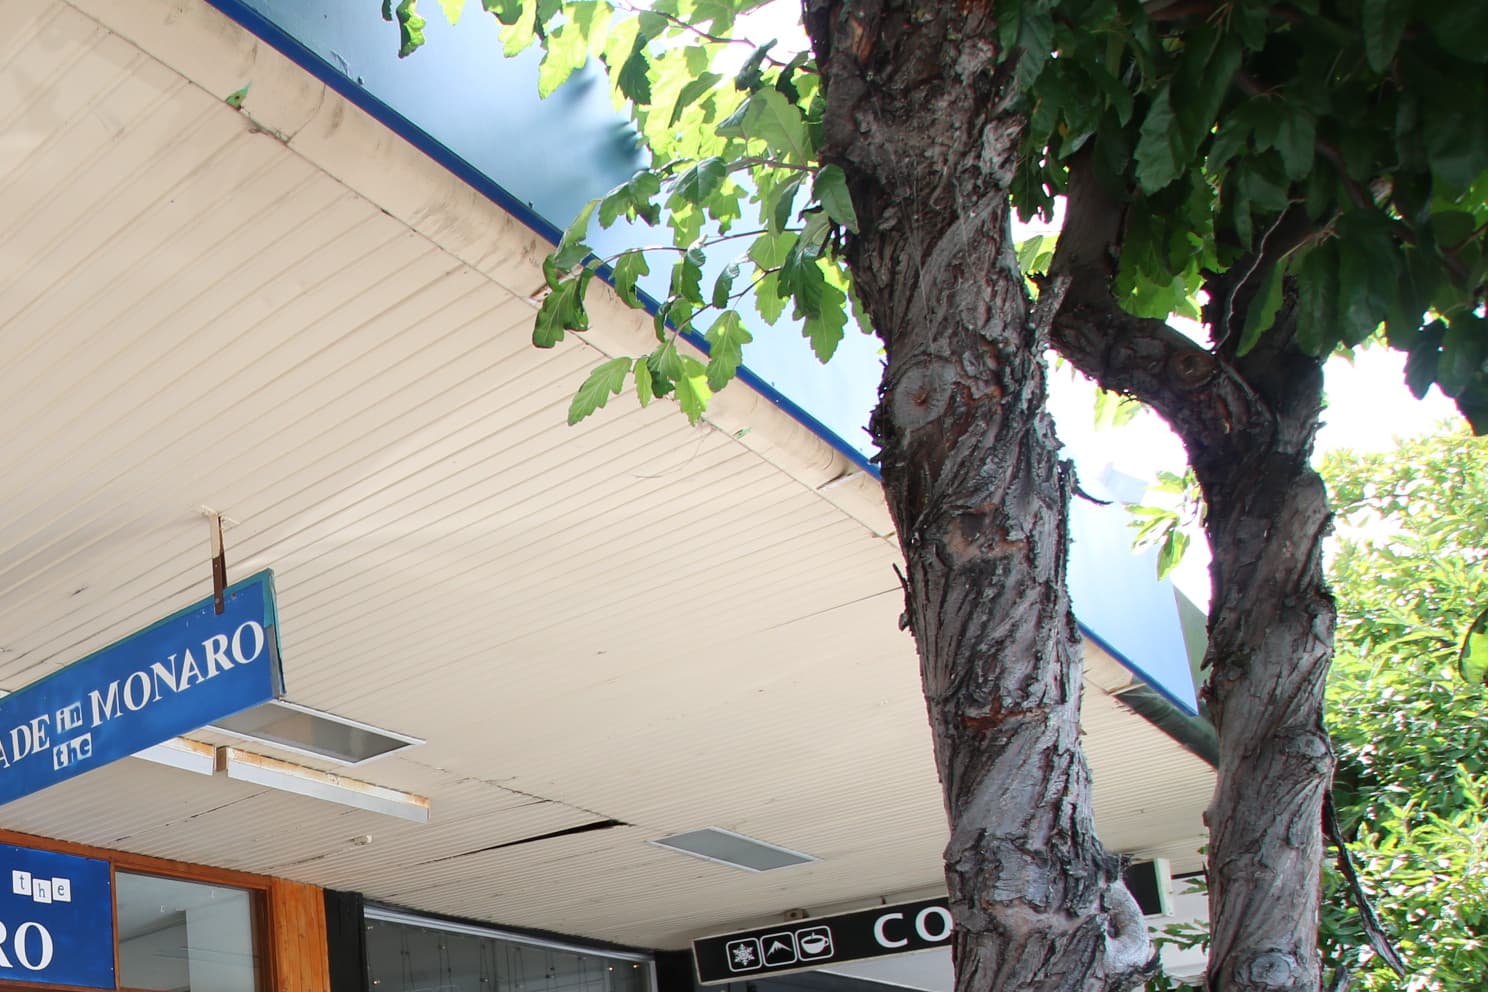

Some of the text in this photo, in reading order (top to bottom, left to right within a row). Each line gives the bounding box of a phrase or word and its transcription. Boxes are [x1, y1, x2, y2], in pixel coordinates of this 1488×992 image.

[89, 621, 264, 728] MONARO
[57, 703, 82, 733] in
[54, 734, 92, 769] the
[16, 873, 68, 900] the
[873, 906, 953, 948] CO
